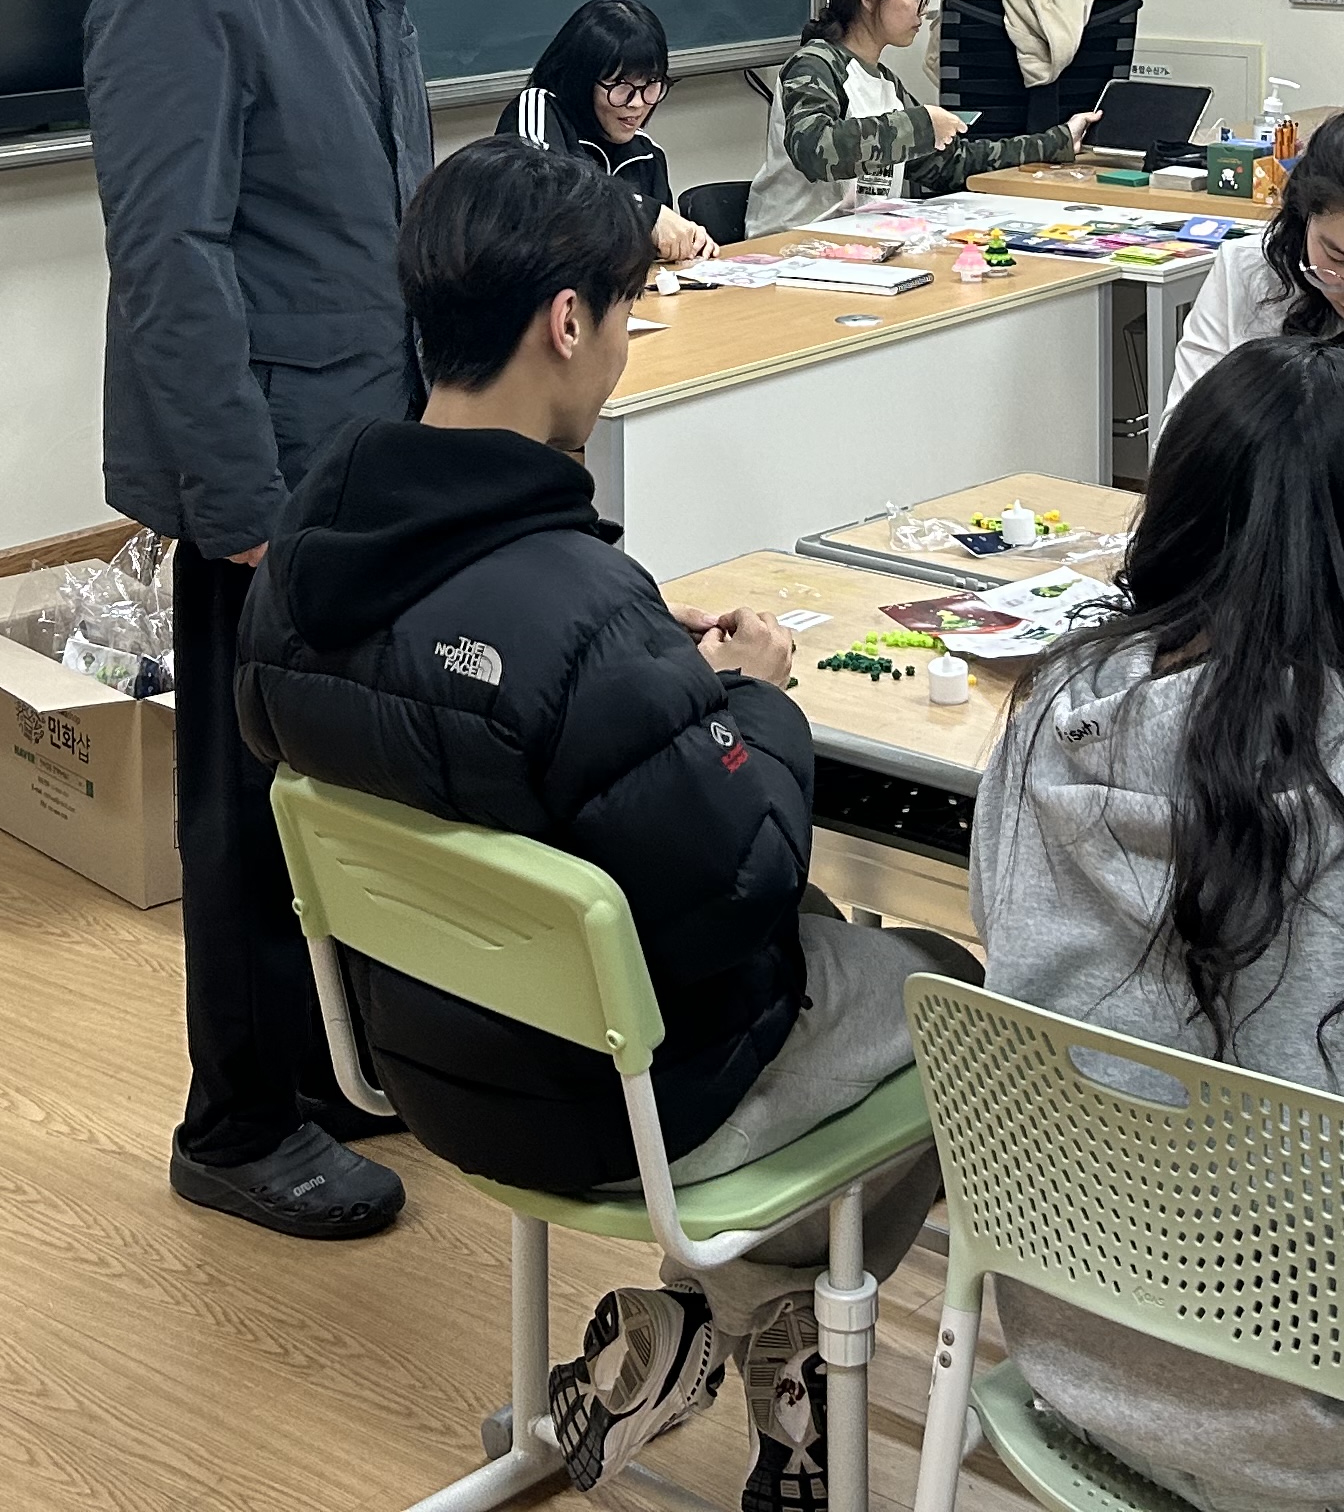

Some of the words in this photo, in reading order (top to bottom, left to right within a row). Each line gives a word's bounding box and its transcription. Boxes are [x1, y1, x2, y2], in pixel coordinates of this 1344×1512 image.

[434, 641, 482, 670] NORTH
[458, 636, 486, 656] THE
[443, 657, 478, 679] FACE
[47, 715, 91, 765] 민화샵
[292, 1174, 327, 1197] arena
